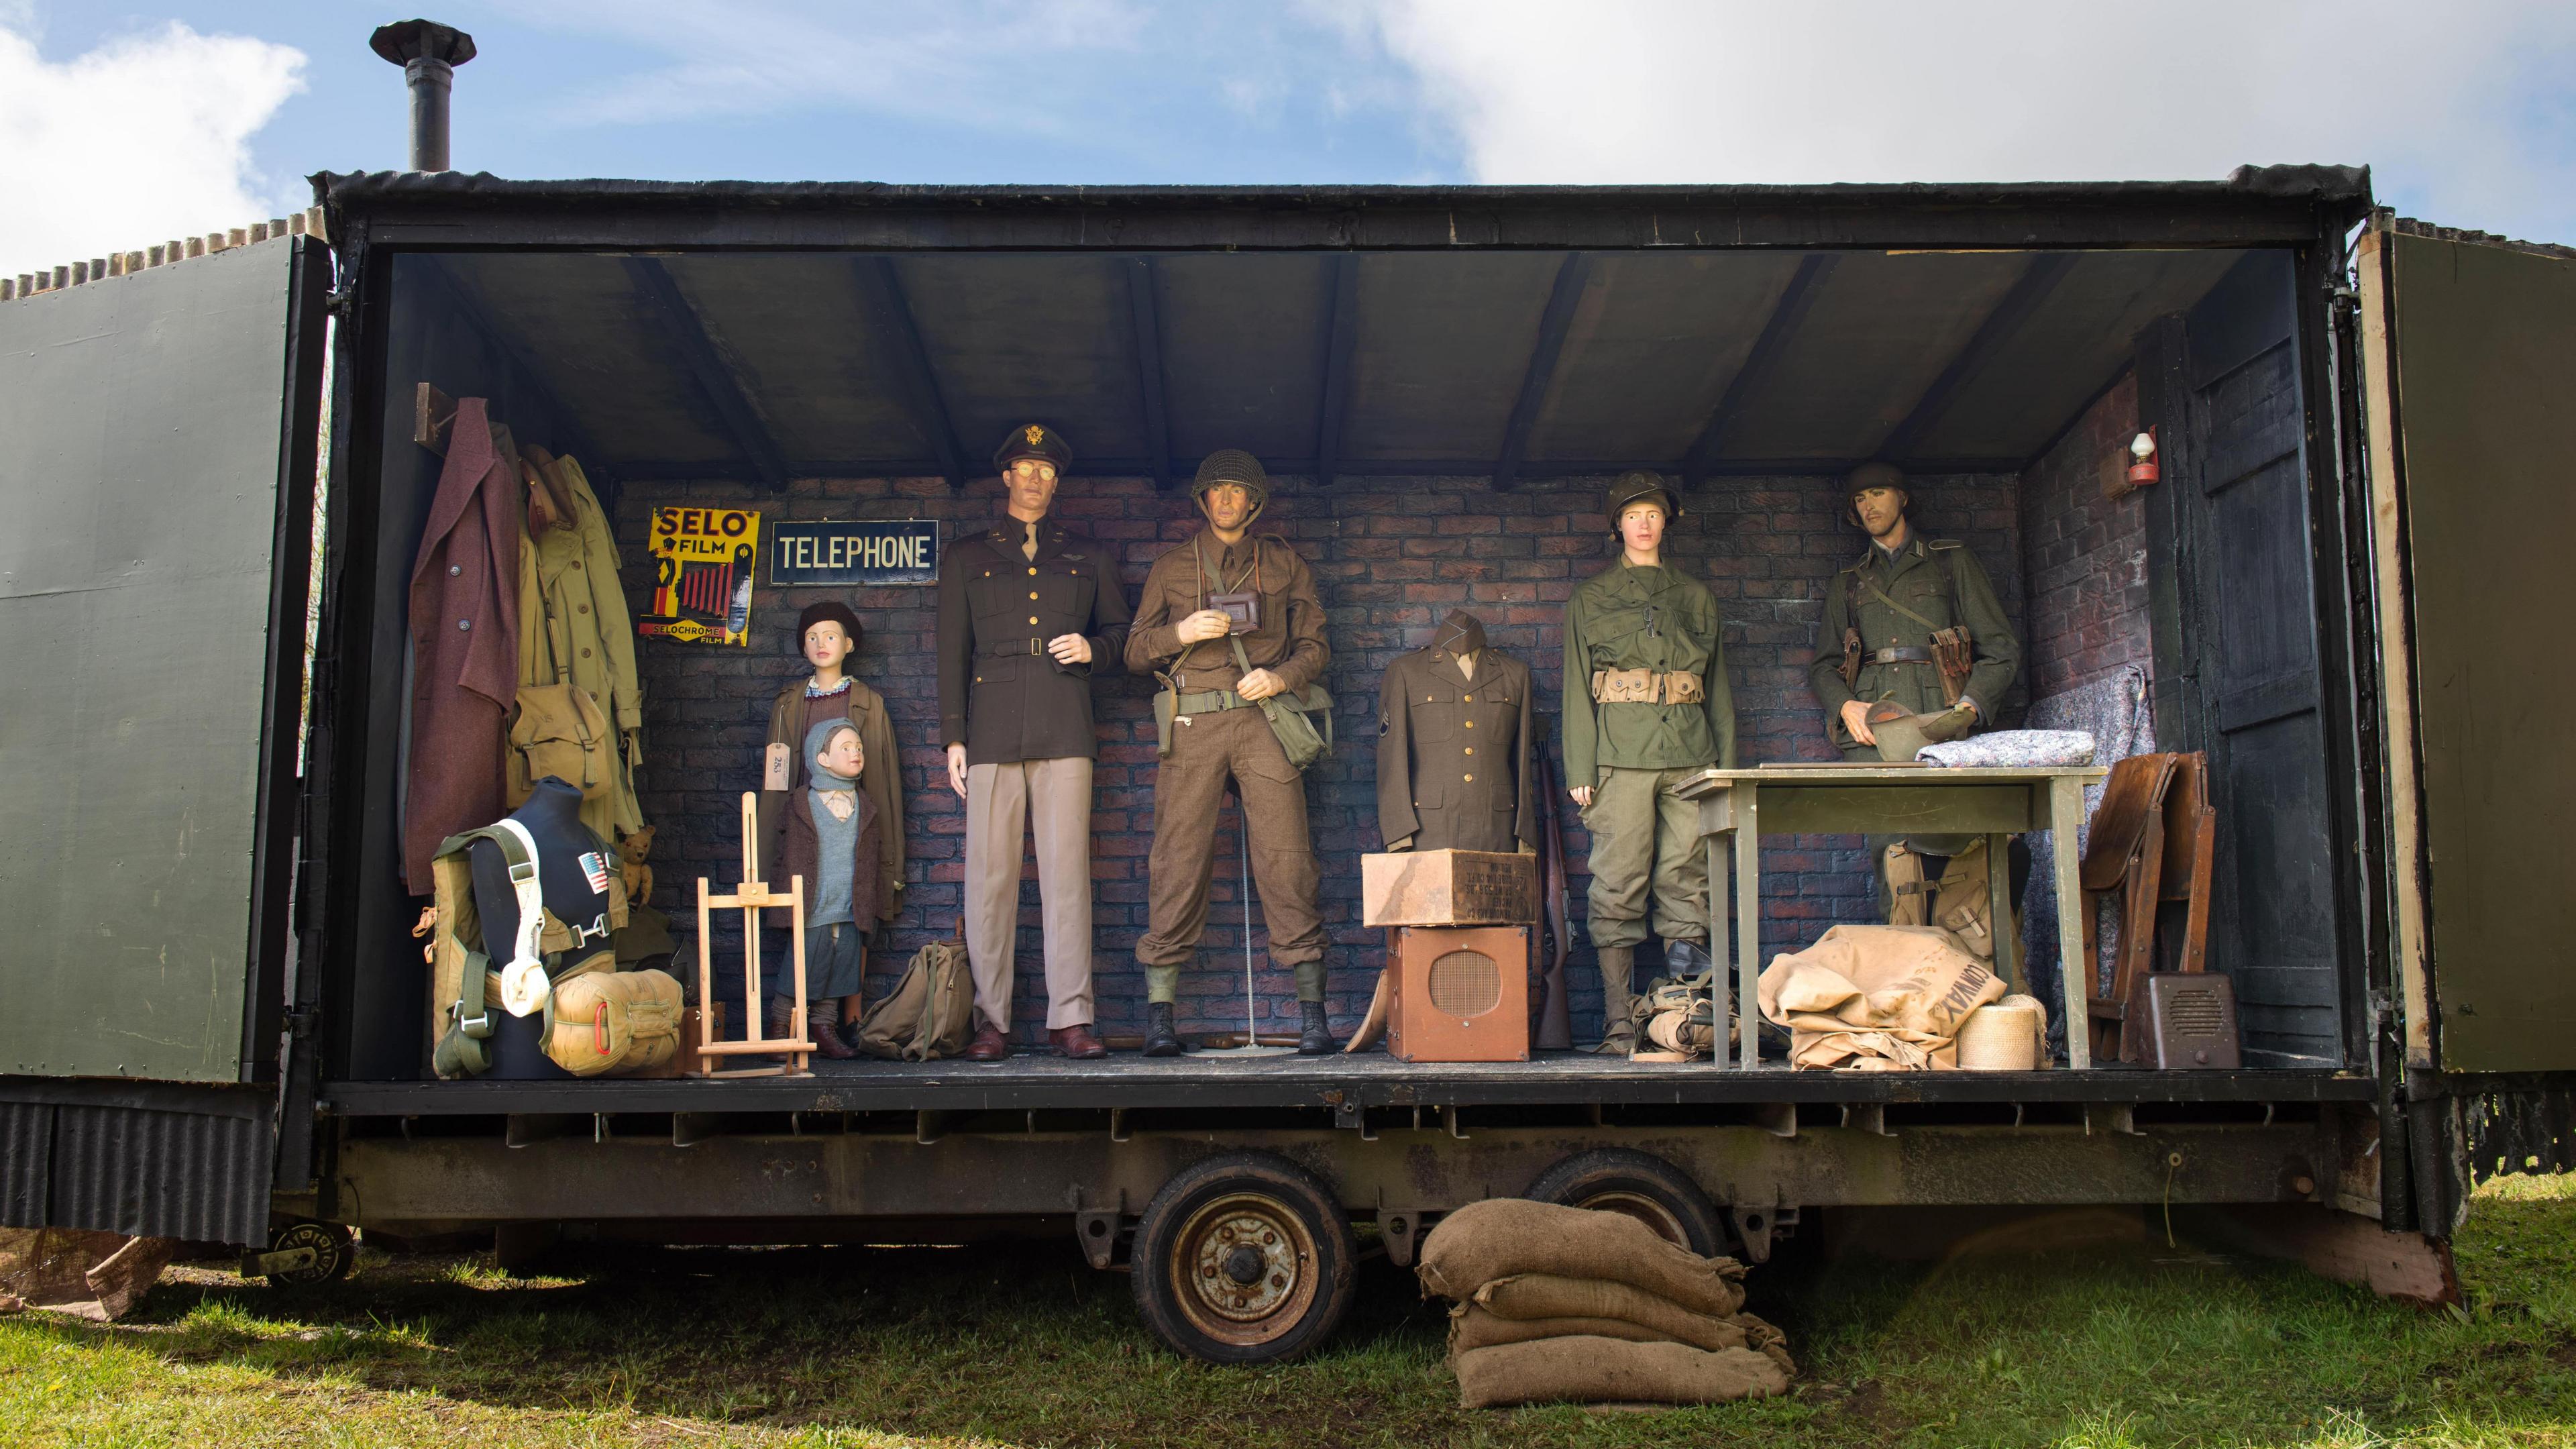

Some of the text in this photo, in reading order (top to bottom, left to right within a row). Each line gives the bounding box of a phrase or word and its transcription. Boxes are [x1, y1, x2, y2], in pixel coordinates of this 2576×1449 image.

[657, 508, 747, 537] SELO
[679, 539, 726, 554] FILM
[779, 536, 930, 568] TELEPHONE
[653, 625, 720, 636] SELOCHROME
[773, 757, 782, 773] 253
